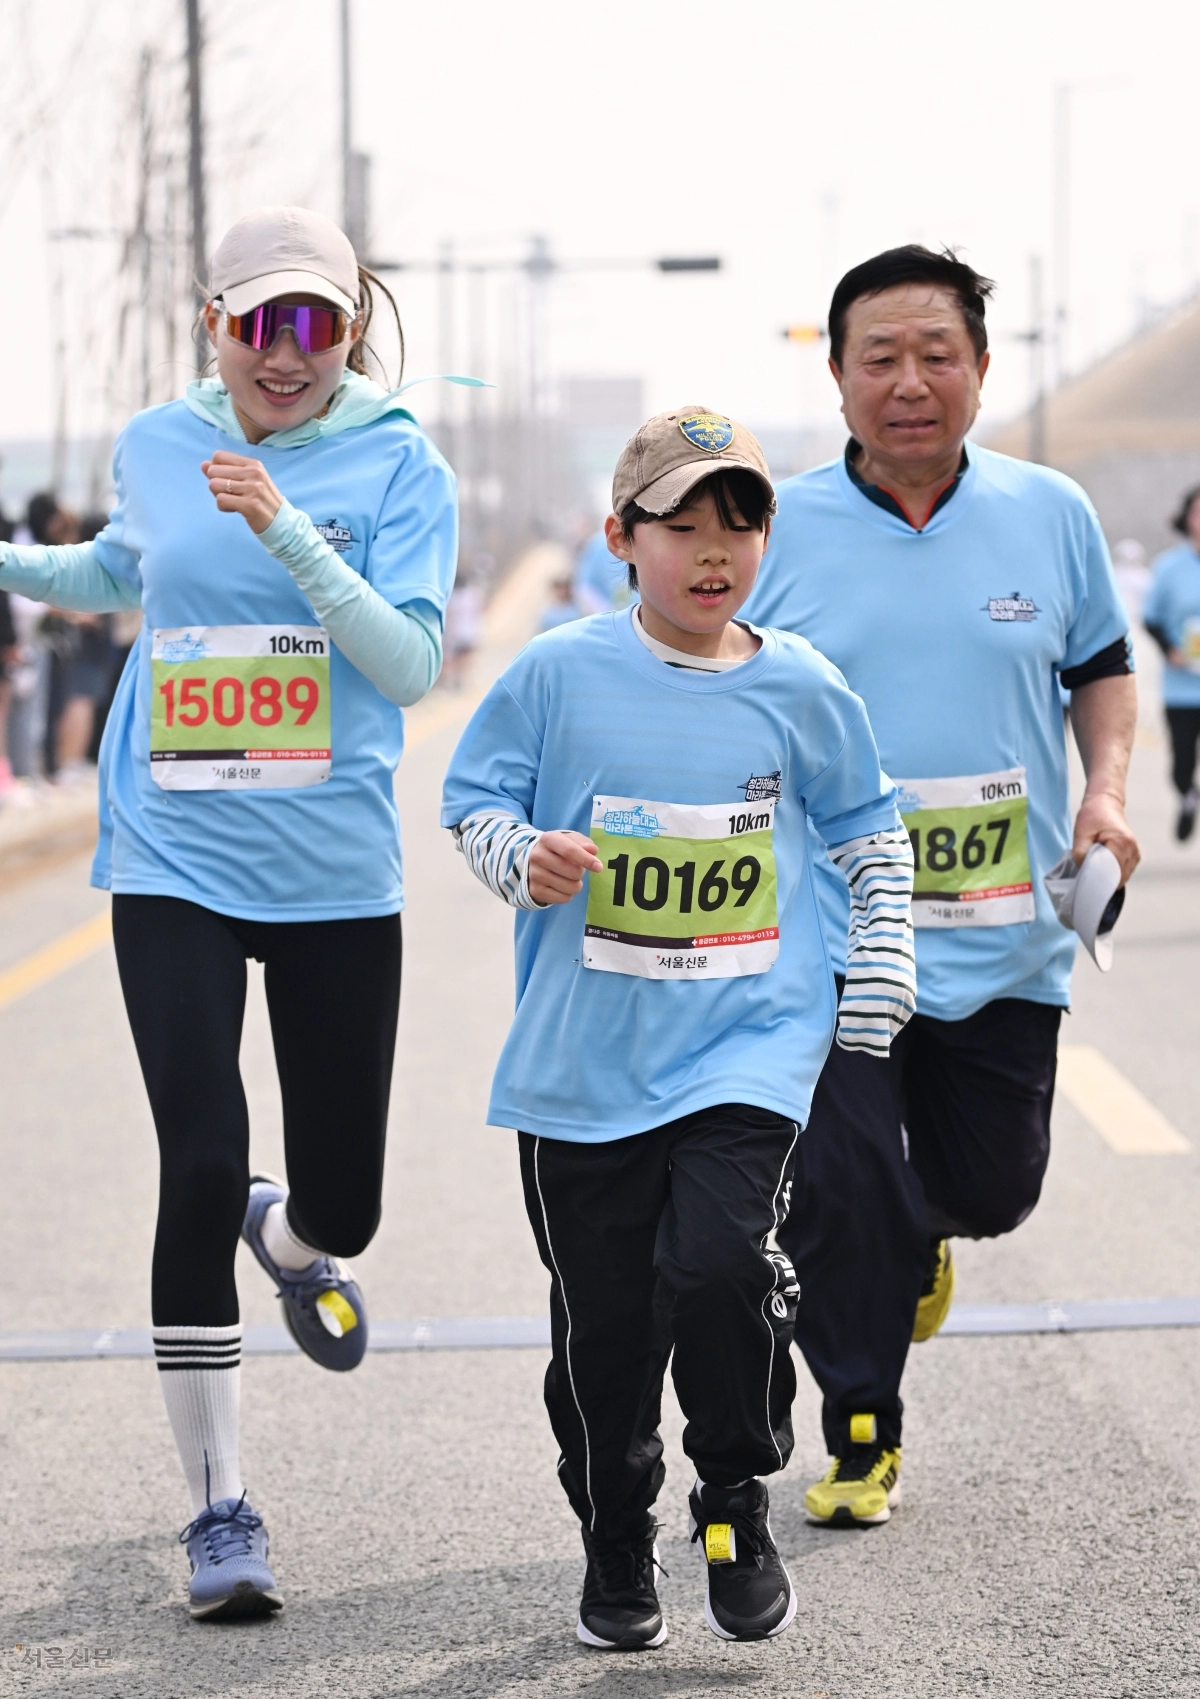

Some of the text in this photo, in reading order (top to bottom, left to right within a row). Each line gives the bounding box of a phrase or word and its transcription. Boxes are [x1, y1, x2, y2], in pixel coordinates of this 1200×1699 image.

[270, 635, 324, 654] 10km
[159, 676, 319, 727] 15089
[215, 767, 262, 780] 서울신문
[981, 781, 1022, 802] 10km
[604, 812, 658, 828] 청라하늘대교
[605, 822, 634, 835] 마라톤
[729, 812, 770, 835] 10km
[607, 853, 762, 914] 10169
[722, 930, 775, 942] 010-4794-0119
[658, 956, 708, 969] 서울신문
